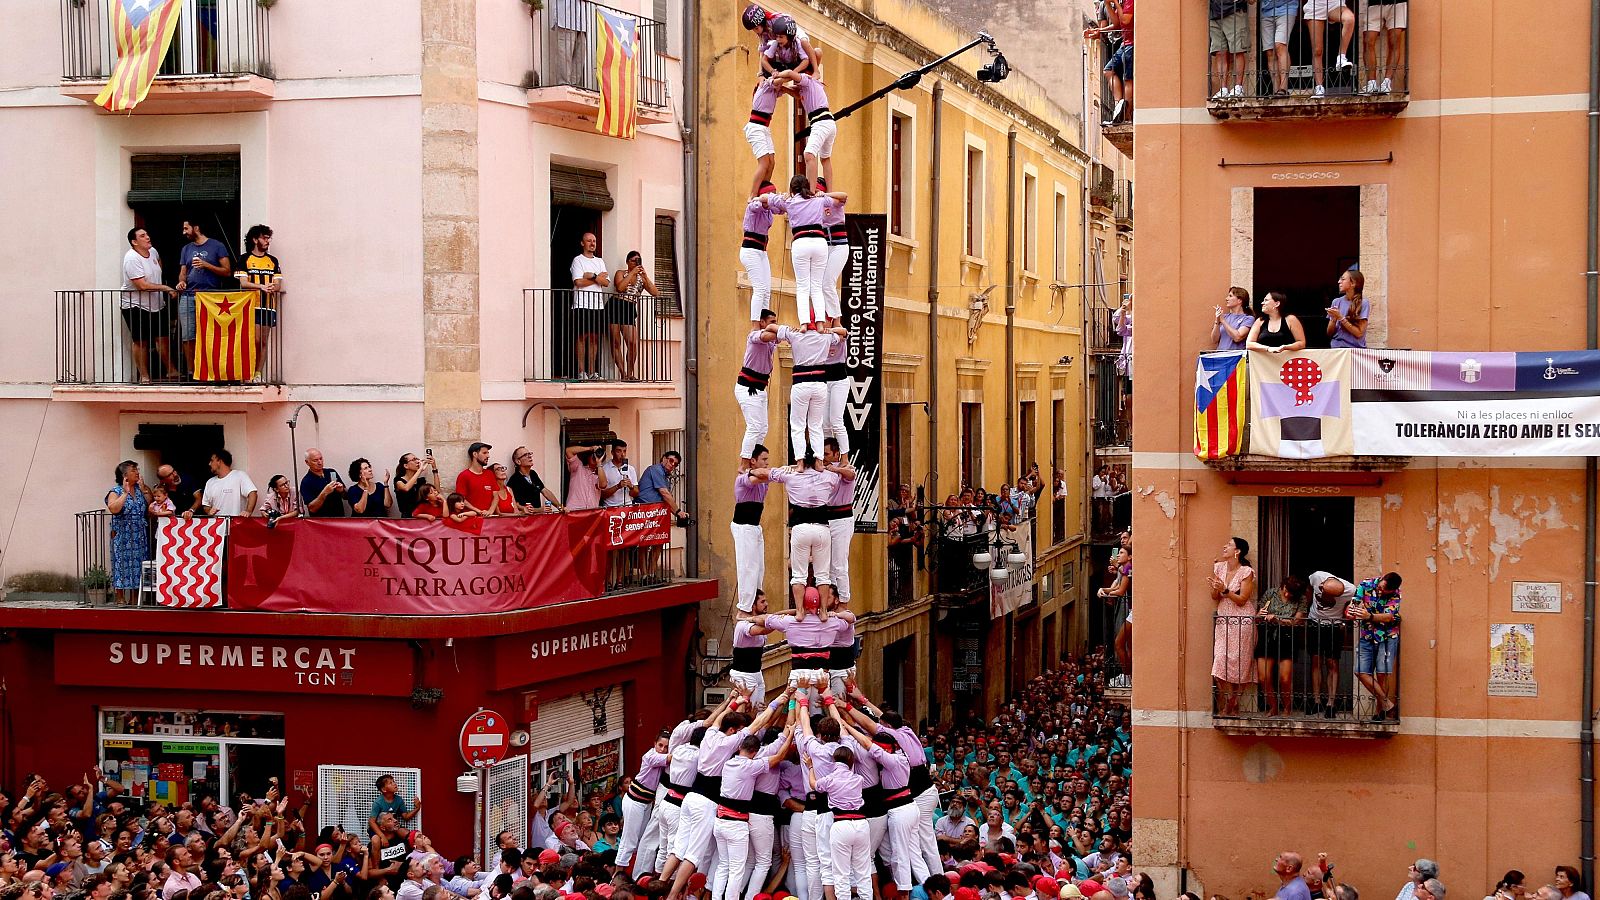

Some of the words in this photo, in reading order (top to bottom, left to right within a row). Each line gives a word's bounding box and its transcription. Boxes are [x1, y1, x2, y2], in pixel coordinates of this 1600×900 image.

[848, 245, 863, 310] Cultural
[863, 227, 879, 322] Ajuntament
[846, 313, 861, 369] Centre
[862, 326, 875, 368] Antic
[1457, 410, 1468, 419] Ni
[1479, 410, 1493, 419] les
[1495, 410, 1527, 421] places
[1530, 410, 1540, 419] ni
[1542, 409, 1574, 419] enlloc
[1395, 421, 1480, 438] TOLERÀNCIA
[1483, 424, 1518, 439] ZERO
[1520, 424, 1553, 439] AMB
[1557, 424, 1571, 438] EL
[364, 535, 527, 574] XIQUETS
[363, 568, 379, 577] DE
[381, 574, 527, 597] TARRAGONA
[531, 624, 634, 659] SUPERMERCAT
[610, 643, 627, 655] TGN
[109, 642, 356, 670] SUPERMERCAT
[294, 671, 336, 686] TGN
